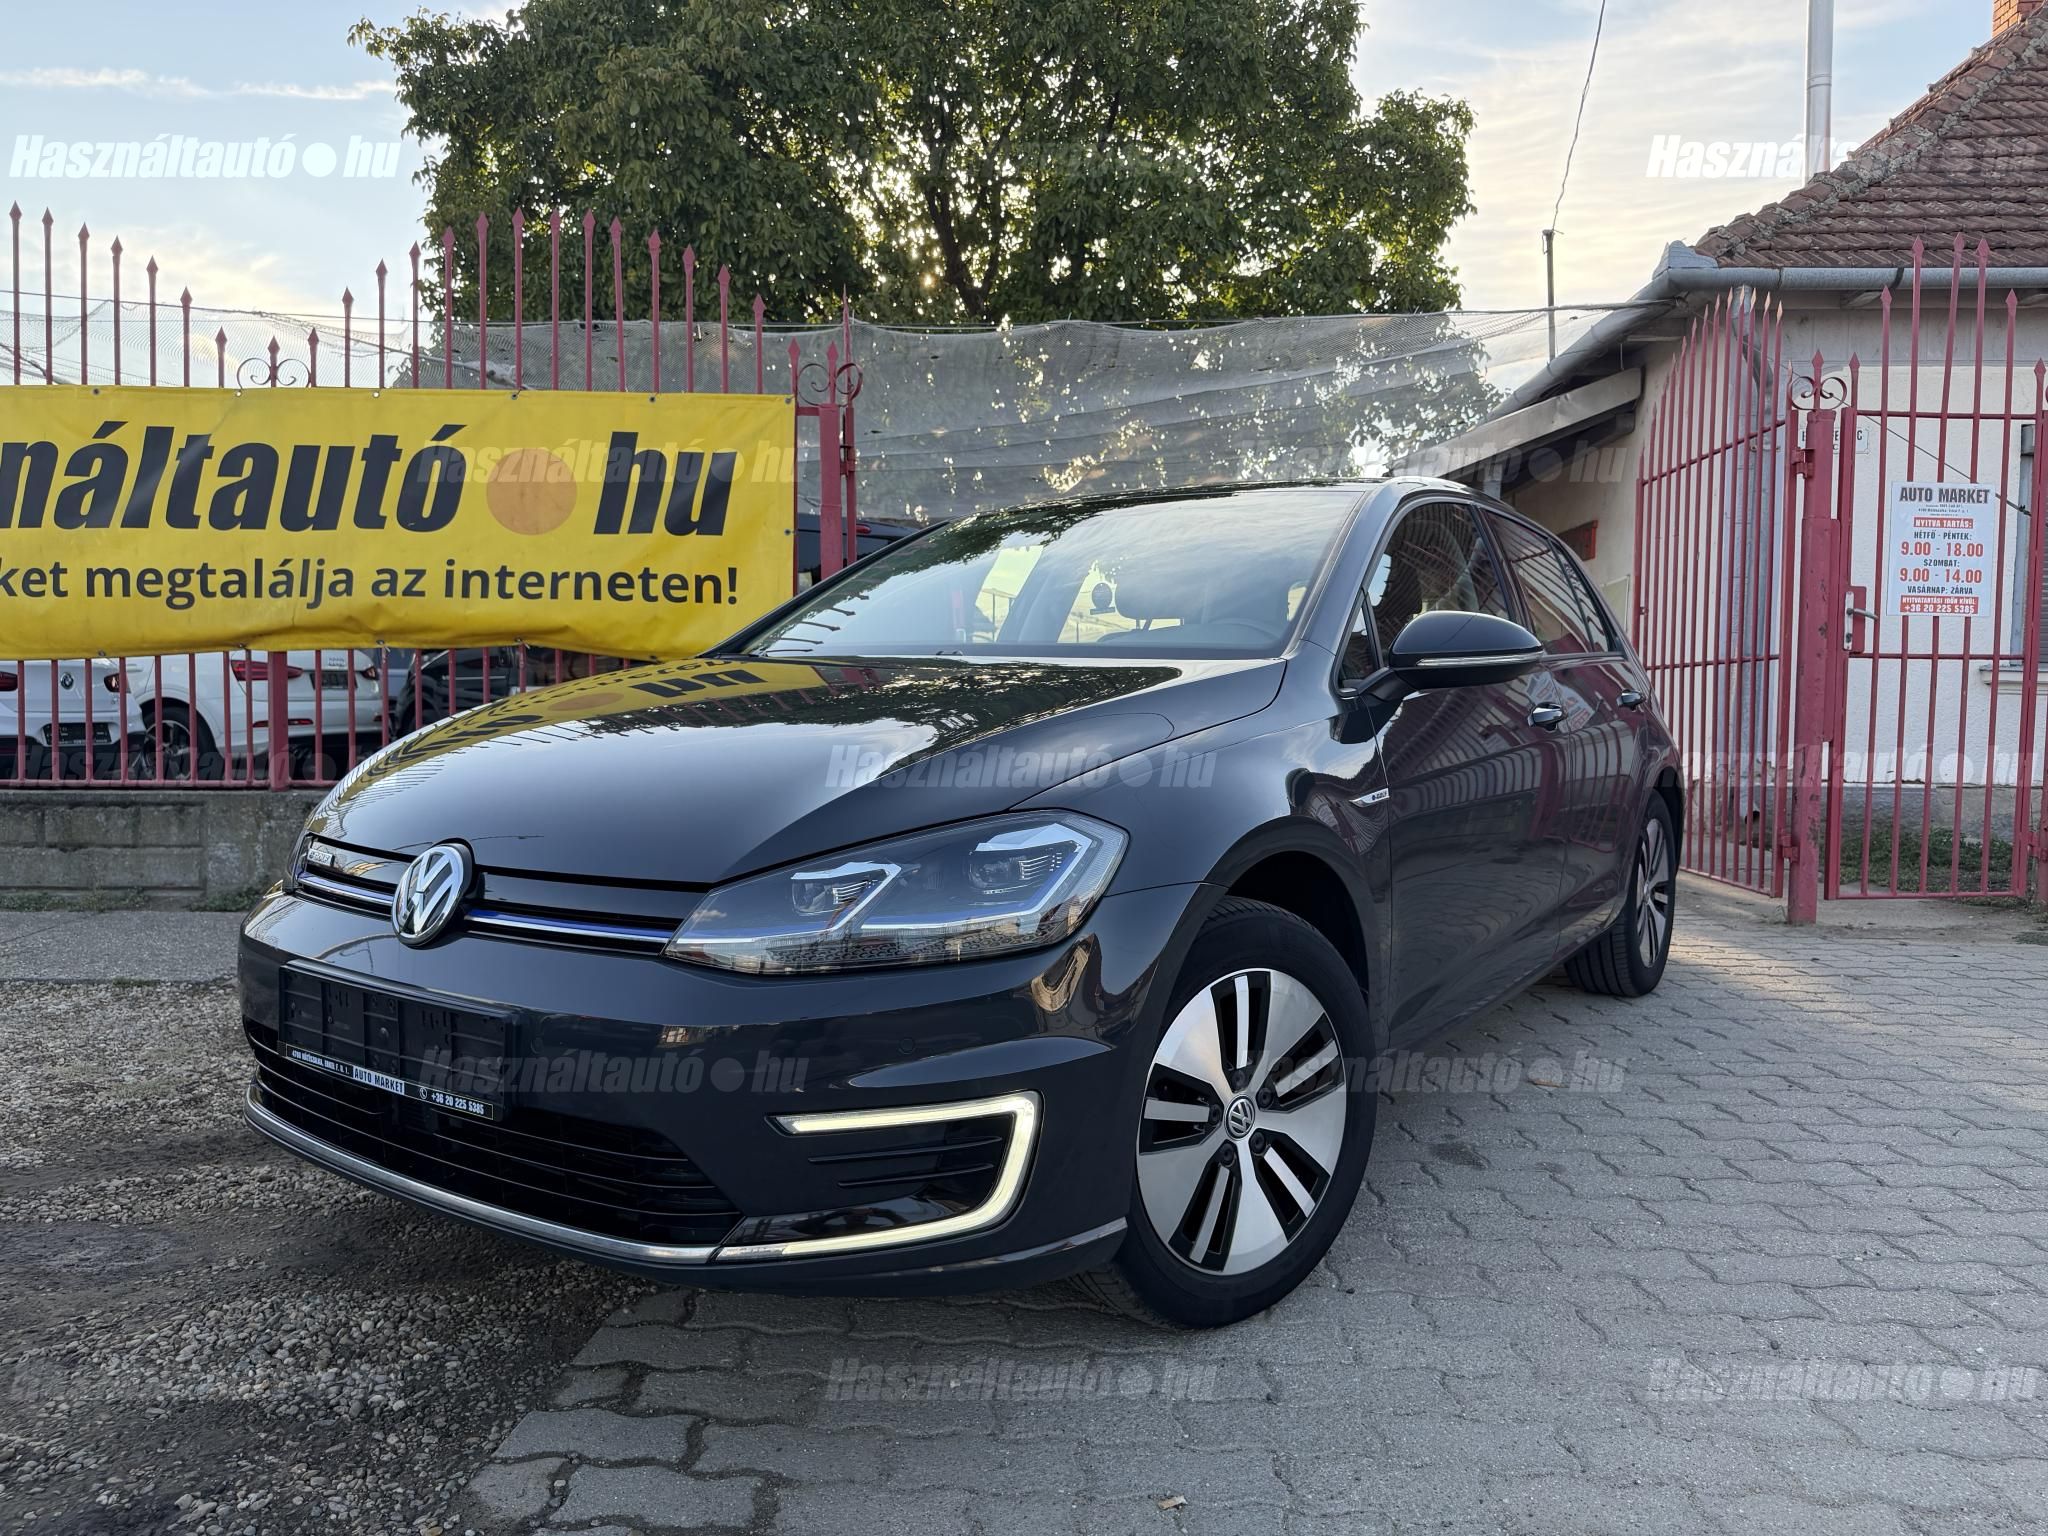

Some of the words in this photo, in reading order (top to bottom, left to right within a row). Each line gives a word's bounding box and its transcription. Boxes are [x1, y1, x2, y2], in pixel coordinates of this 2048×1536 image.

[594, 431, 738, 536] hu
[1900, 487, 1933, 502] AUTO
[1938, 488, 1990, 504] MARKET
[1915, 519, 1941, 528] NYITVA
[1901, 541, 1931, 556] 9.00
[1946, 542, 1983, 557] 18.00
[1923, 558, 1960, 568] SZOMBAT:
[1900, 567, 1930, 582] 9.00
[1945, 568, 1982, 583] 14.00
[86, 558, 354, 610] megtalálja
[371, 566, 427, 597] az
[444, 558, 738, 606] interneten!
[1950, 584, 1973, 595] ZÁRVA
[1904, 604, 1922, 612] +36
[1923, 604, 1935, 612] 20
[1936, 604, 1952, 613] 225
[355, 1068, 372, 1083] AUTO
[374, 1073, 404, 1095] MARKET
[431, 1092, 444, 1103] +36
[445, 1095, 454, 1106] 20
[455, 1098, 467, 1110] 225
[468, 1101, 485, 1115] 5385
